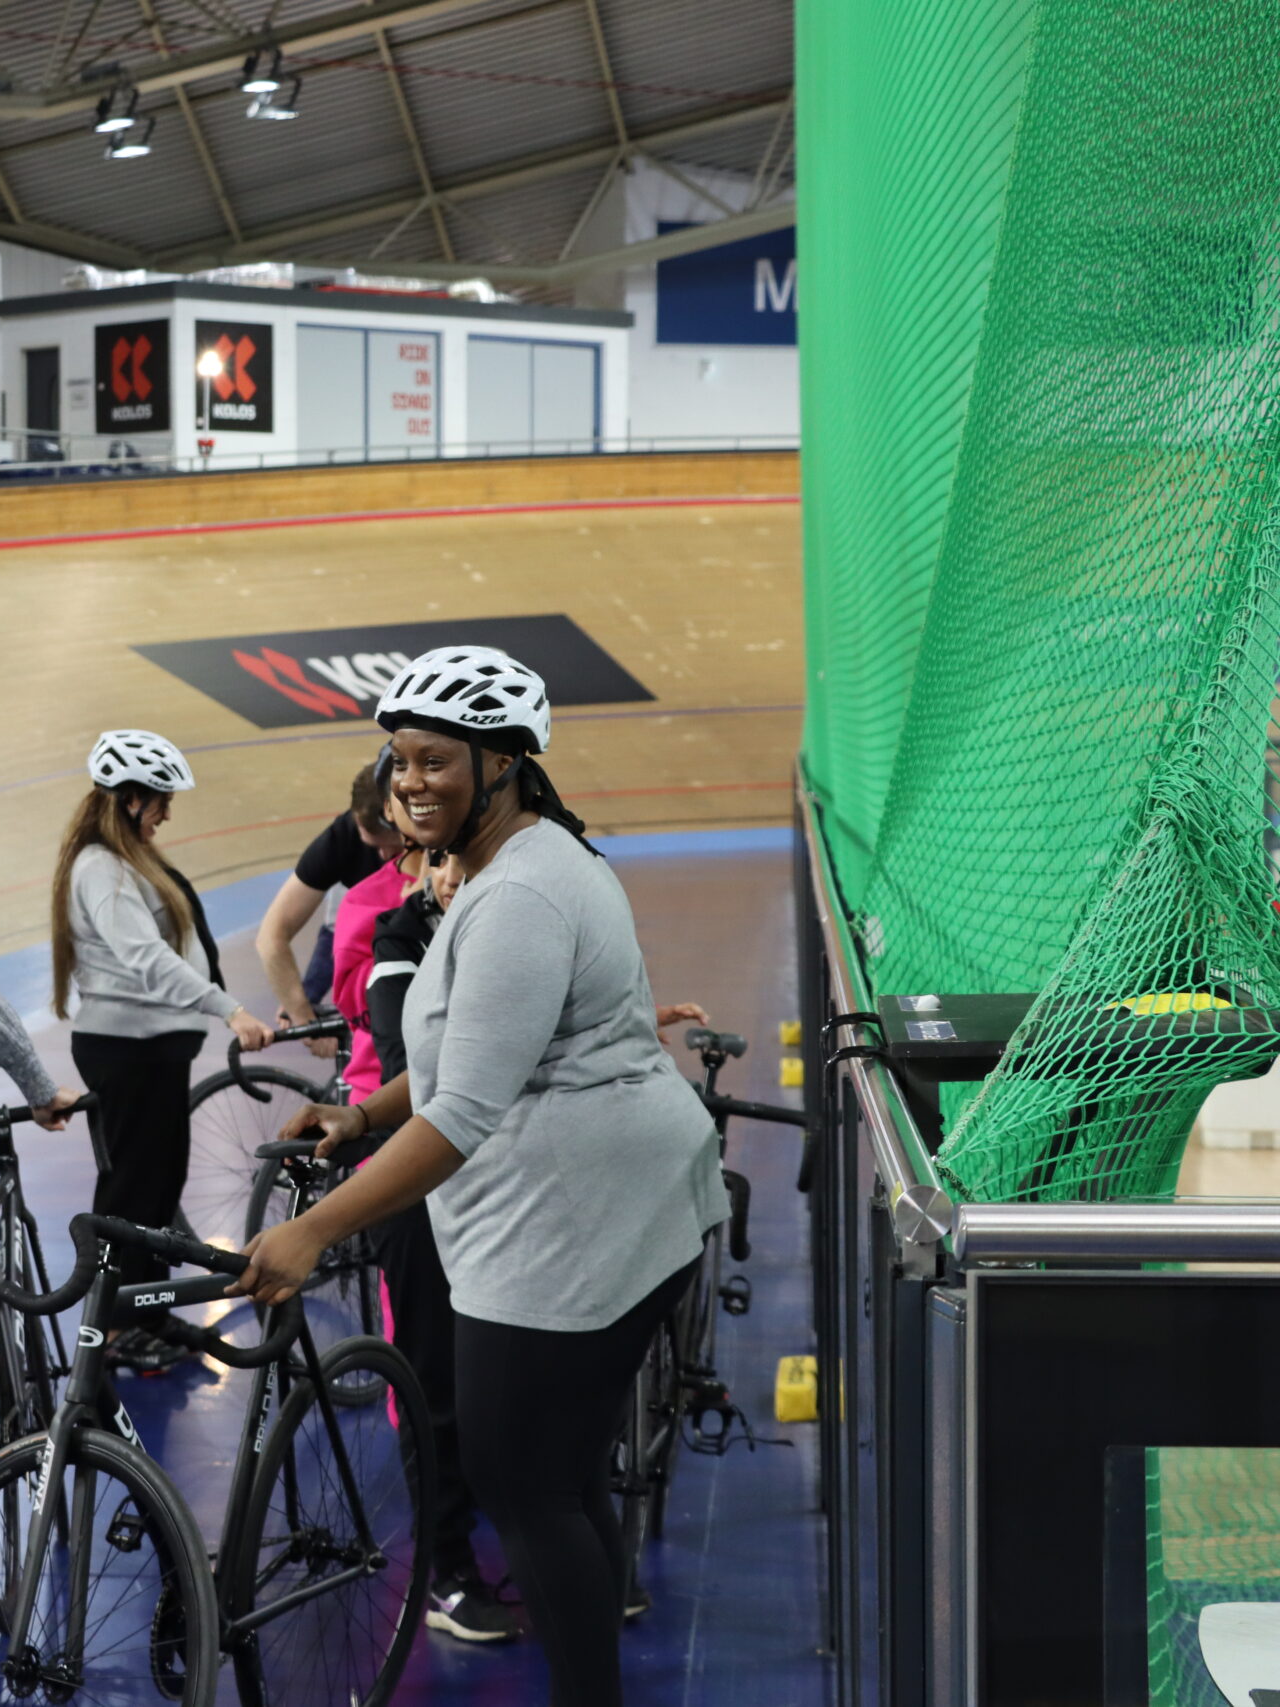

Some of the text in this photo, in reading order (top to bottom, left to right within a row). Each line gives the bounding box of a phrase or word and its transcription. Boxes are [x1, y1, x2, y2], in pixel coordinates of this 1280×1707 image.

[110, 403, 152, 421] KOLOS
[212, 403, 257, 420] KOLOS
[459, 713, 508, 724] LAZER
[134, 1291, 175, 1307] DOLAN
[33, 1437, 55, 1515] ALPINA
